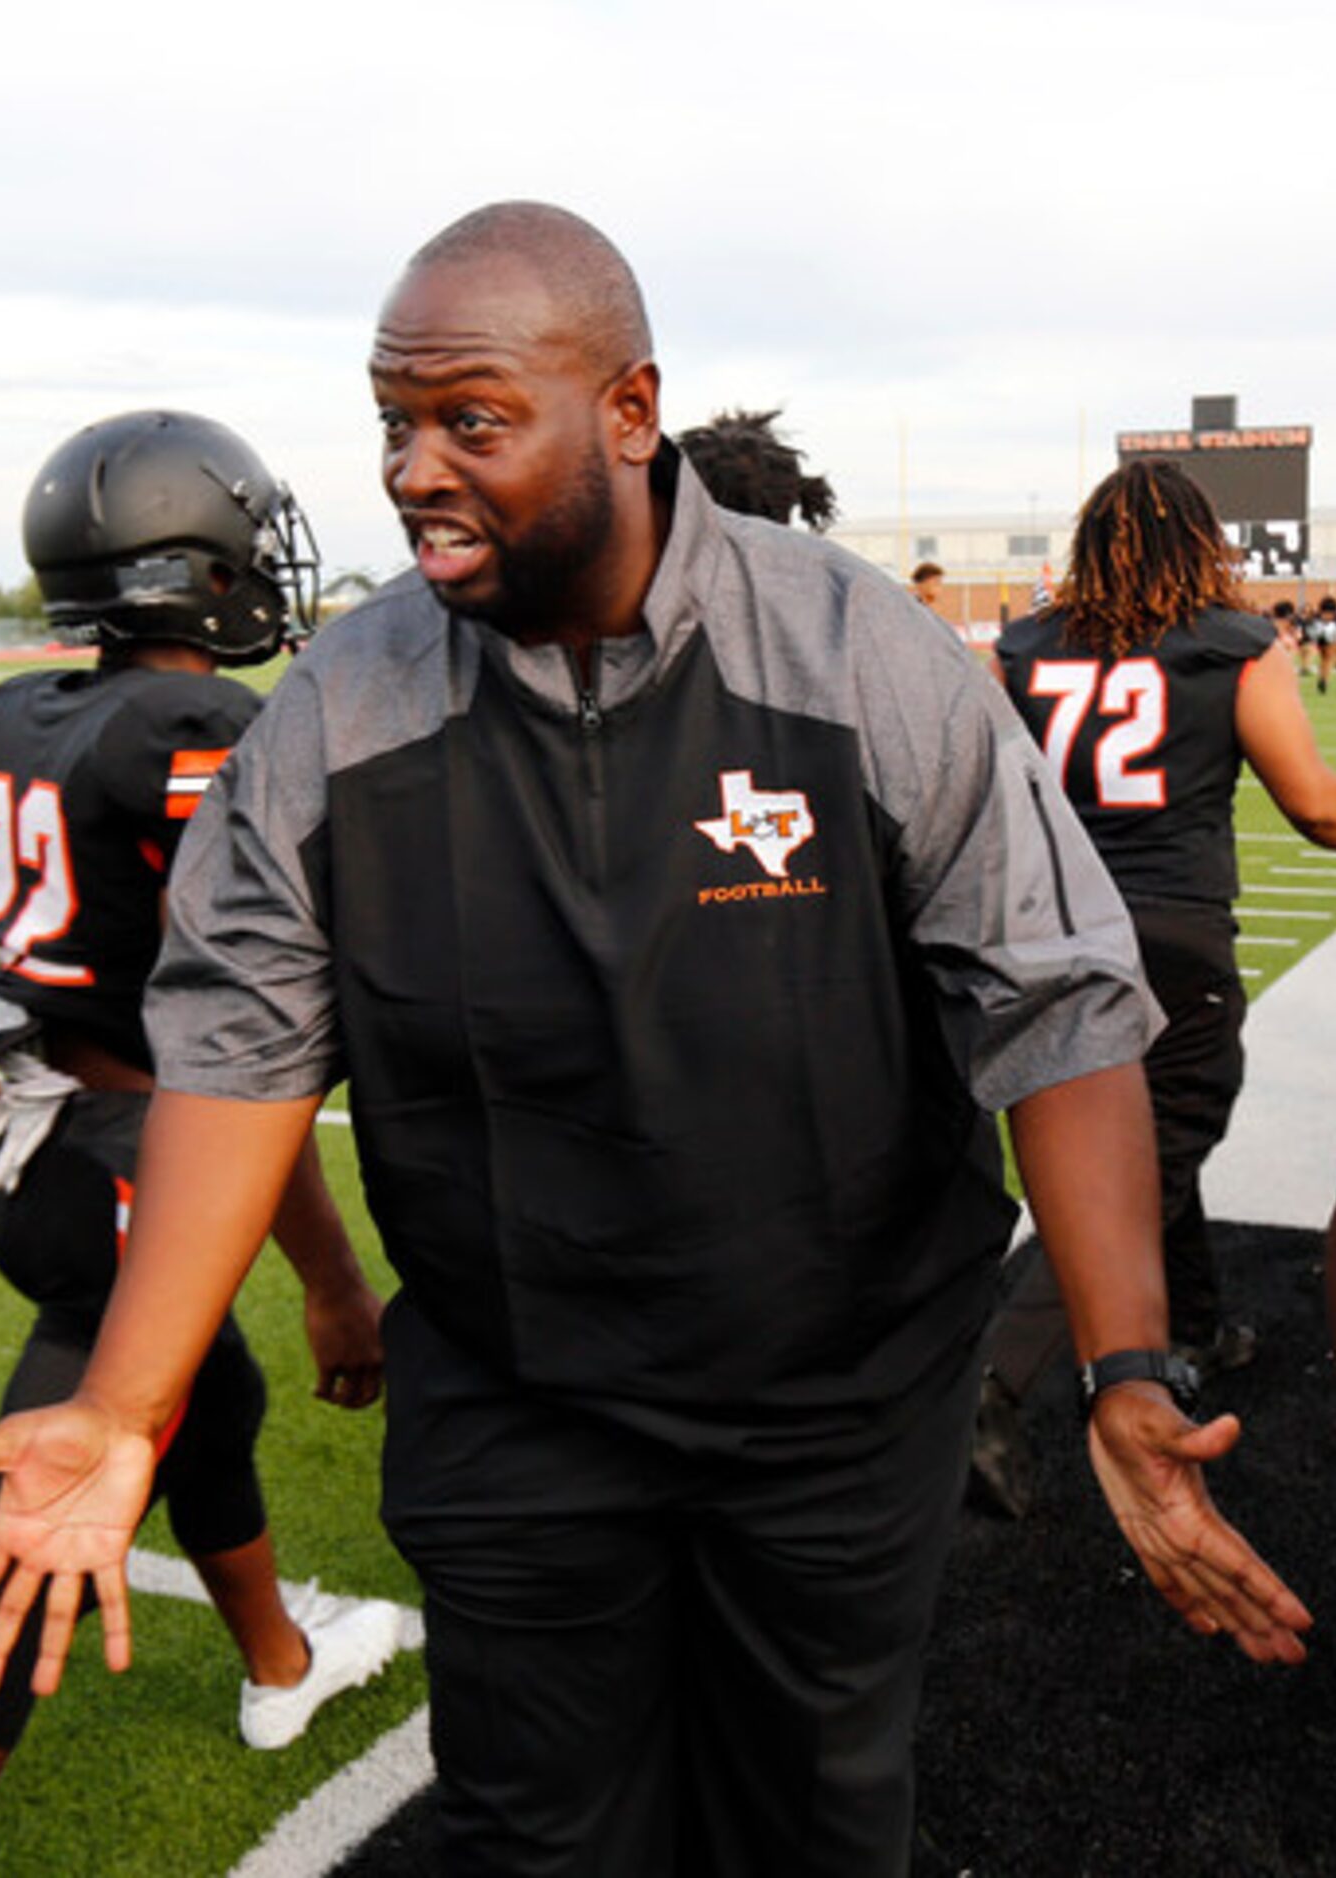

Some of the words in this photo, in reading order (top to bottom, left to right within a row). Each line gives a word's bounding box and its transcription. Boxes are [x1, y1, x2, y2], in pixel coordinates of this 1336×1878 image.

[1199, 425, 1309, 449] STADIUM
[1027, 656, 1169, 808] 72
[698, 877, 827, 906] FOOTBALL
